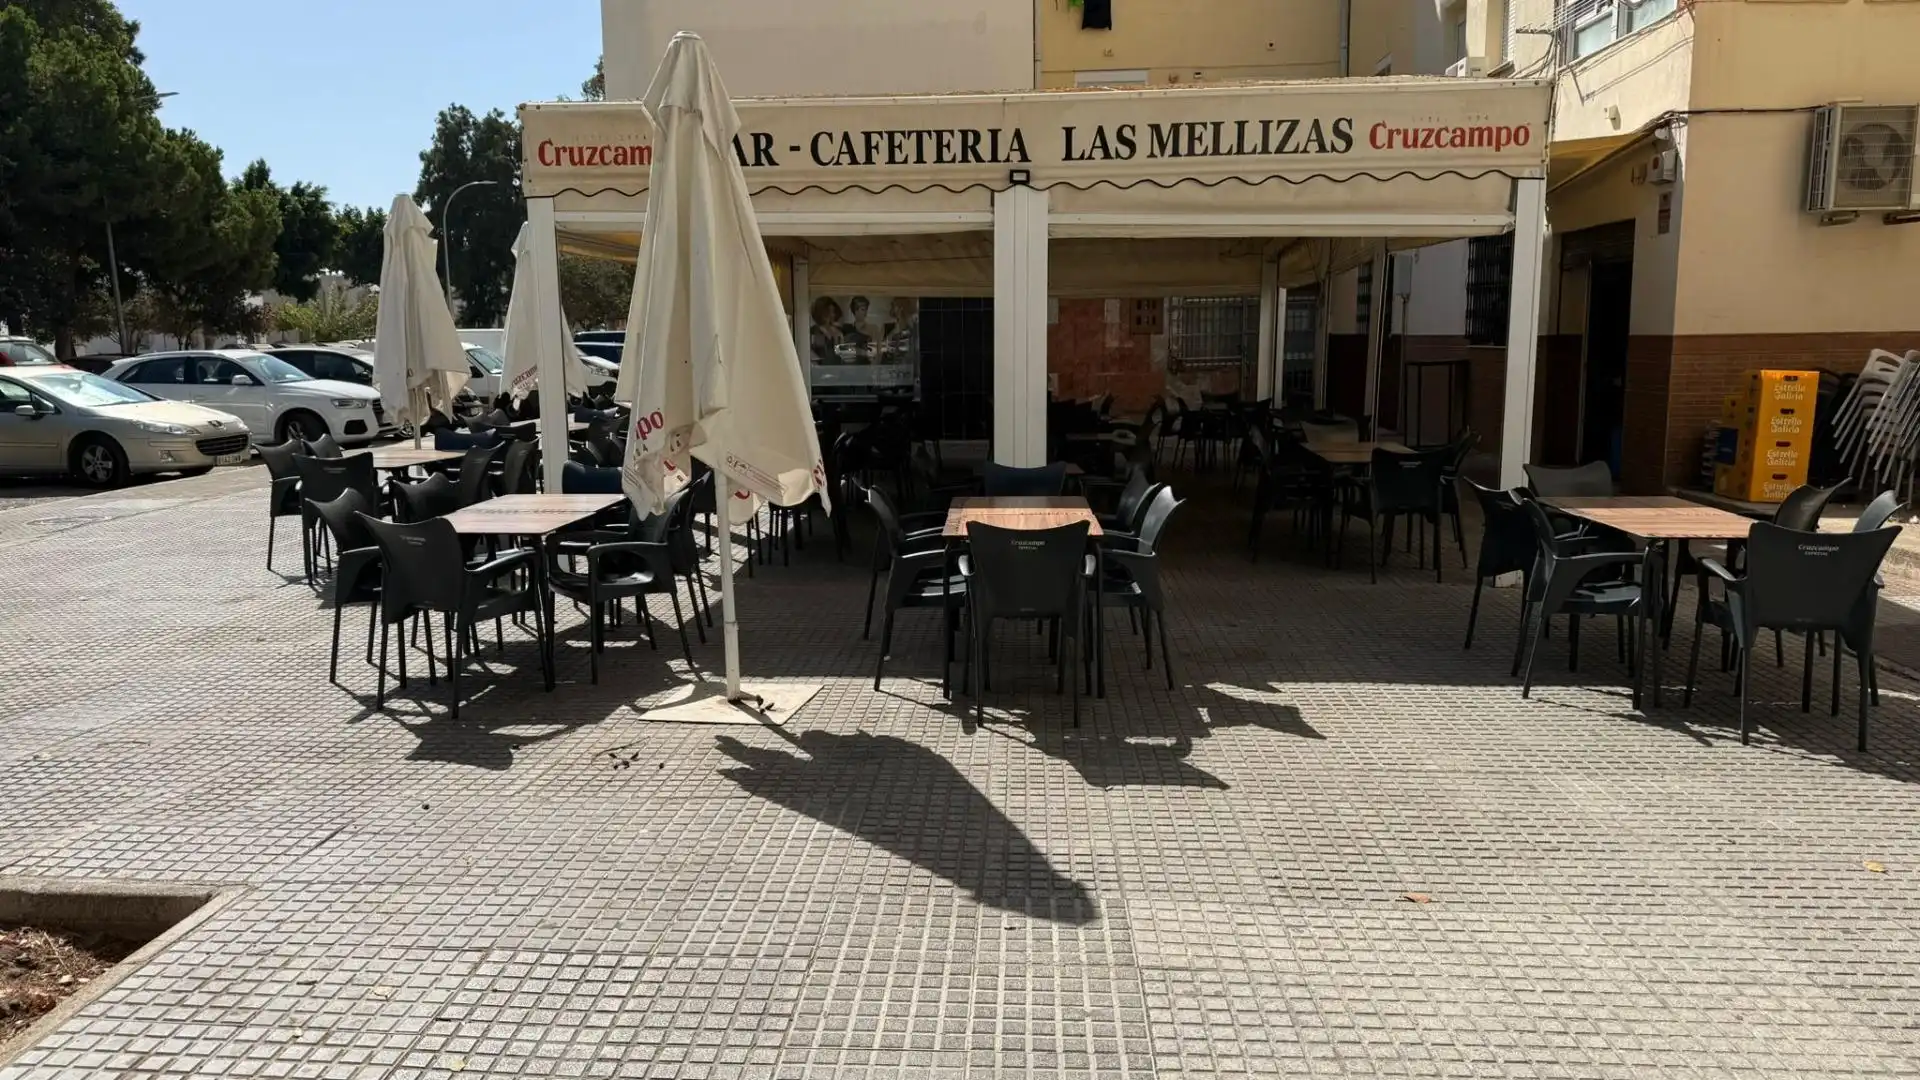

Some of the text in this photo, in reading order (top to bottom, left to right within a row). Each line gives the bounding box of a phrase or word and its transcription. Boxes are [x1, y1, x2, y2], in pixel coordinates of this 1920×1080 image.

[1369, 120, 1530, 152] Cruzcampo
[810, 127, 1032, 166] CAFETERIA
[1062, 124, 1137, 161] LAS
[1147, 117, 1353, 159] MELLIZAS
[538, 138, 652, 166] Cruzcam
[1774, 383, 1806, 392] Estrella
[1774, 391, 1803, 401] Galicia
[1770, 416, 1802, 426] Estrella
[1770, 424, 1800, 434] Galicia
[1766, 449, 1798, 459] Estrella
[1766, 457, 1796, 467] Galicia
